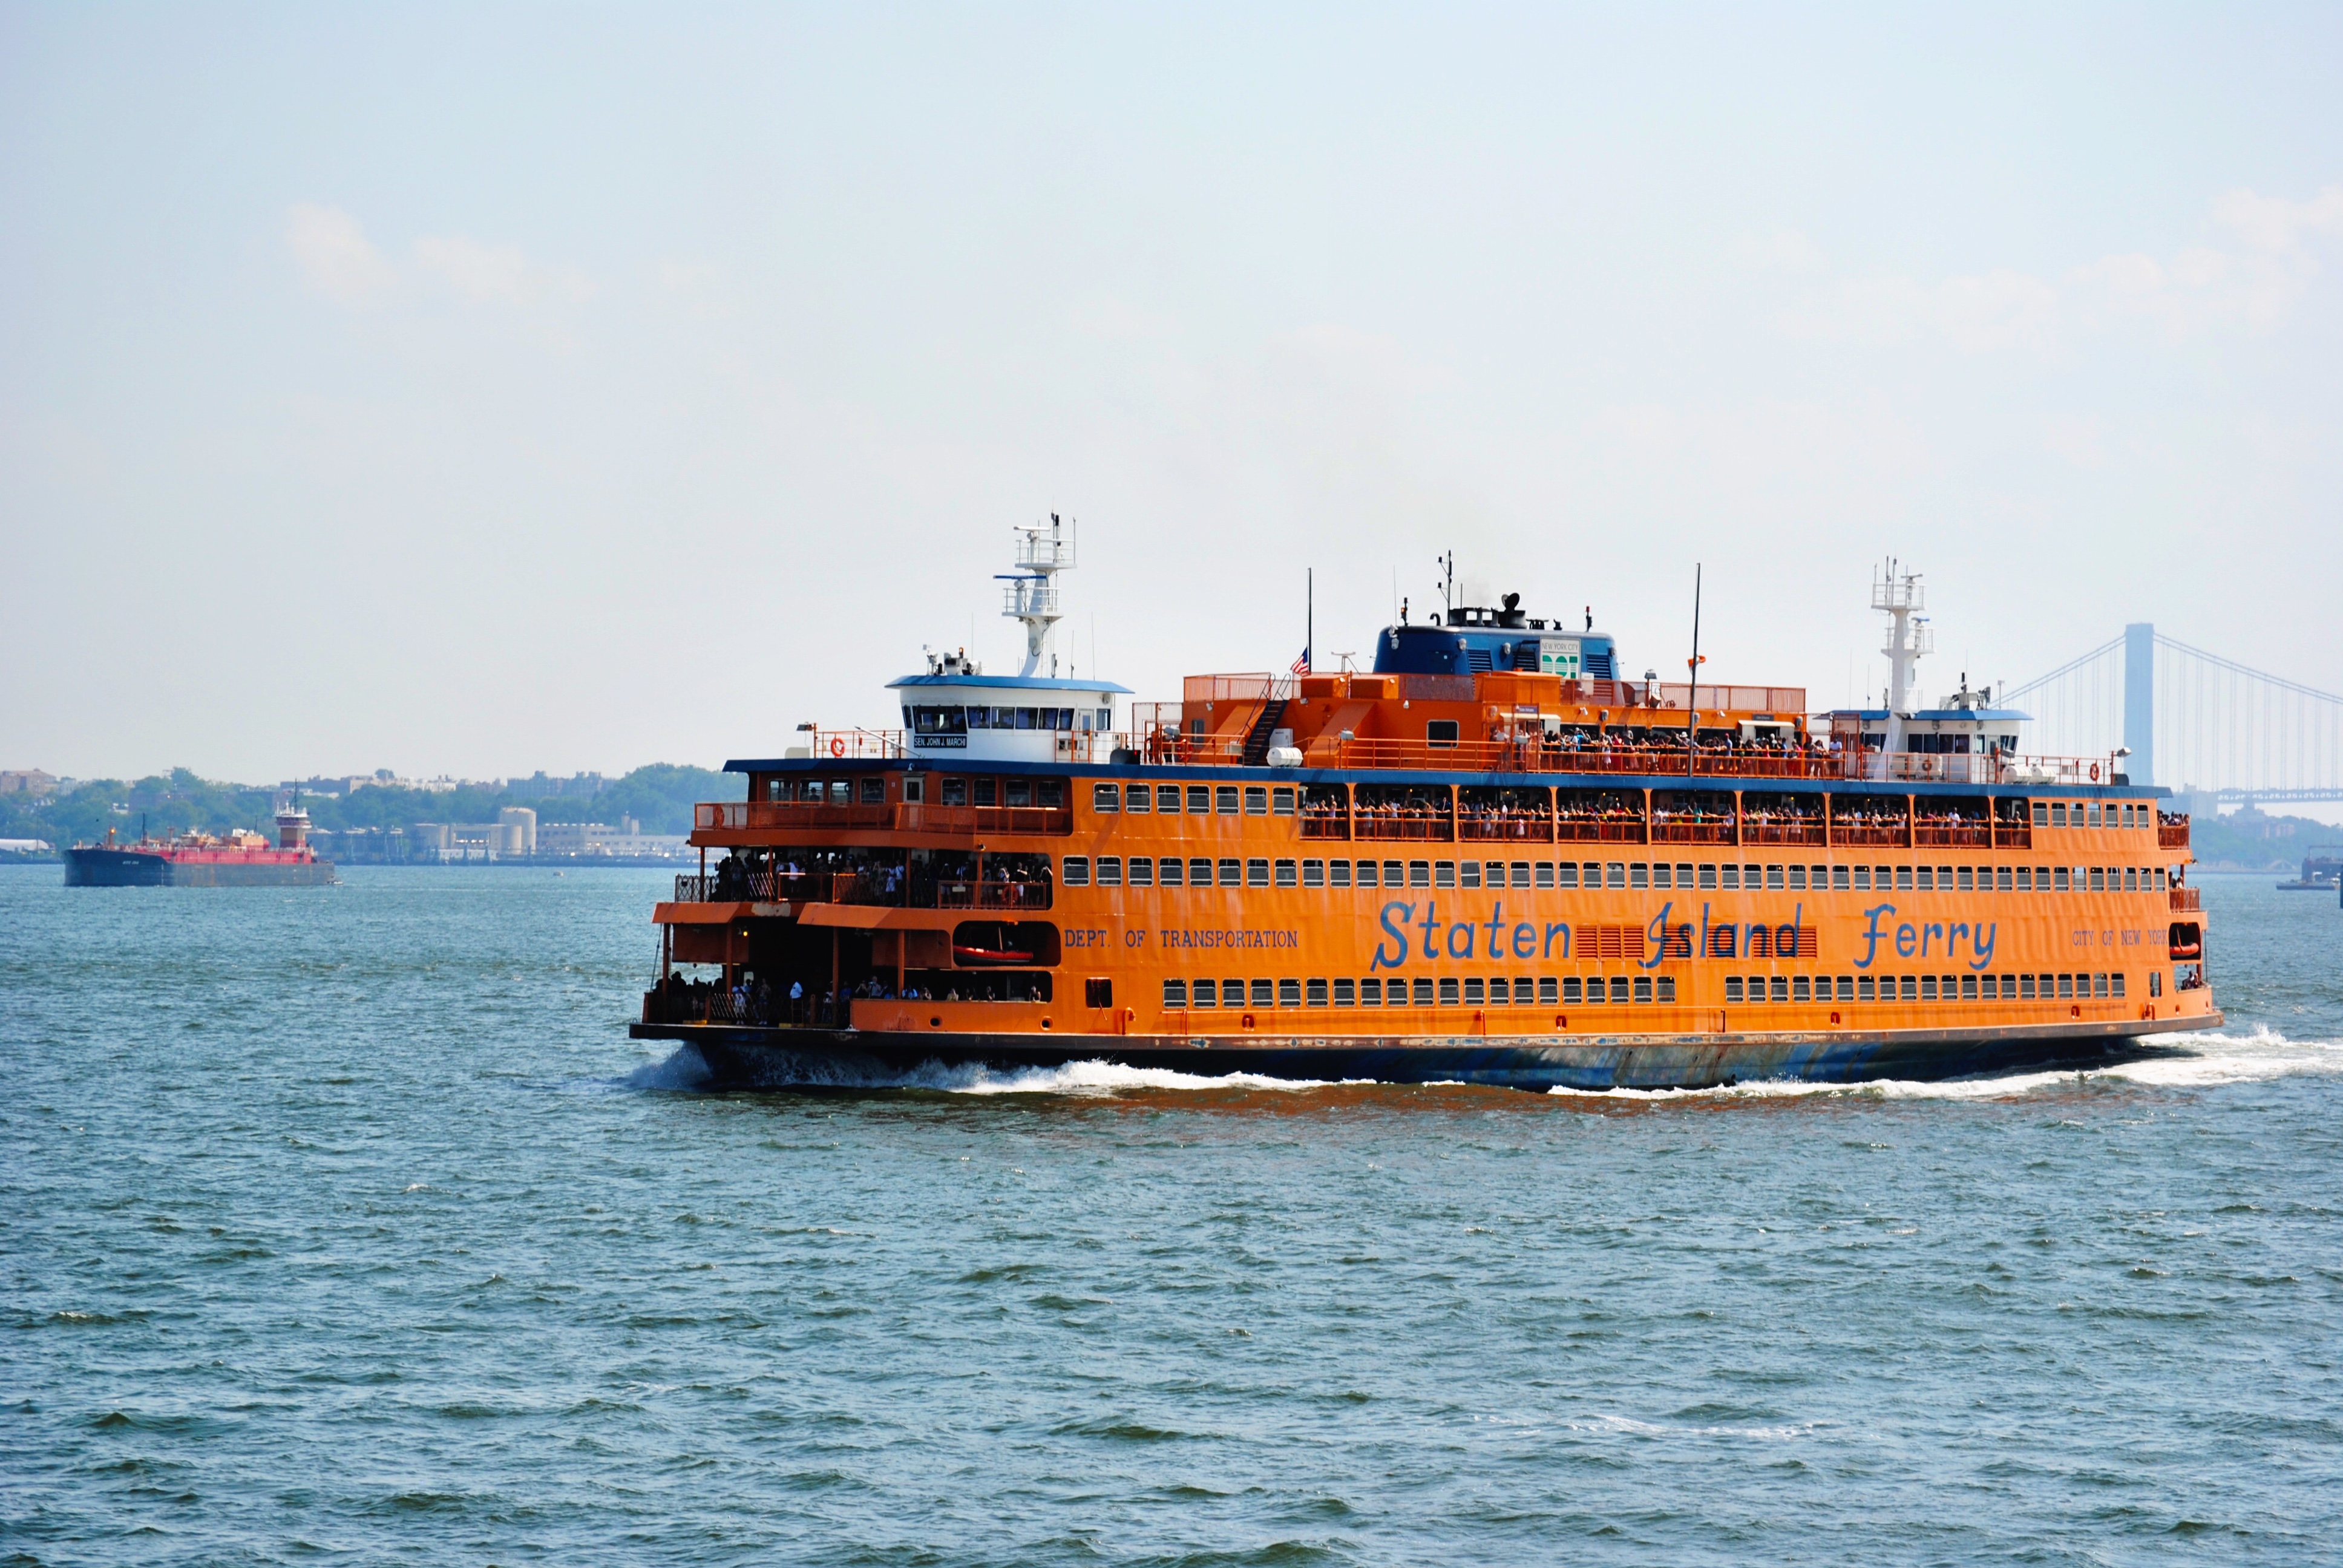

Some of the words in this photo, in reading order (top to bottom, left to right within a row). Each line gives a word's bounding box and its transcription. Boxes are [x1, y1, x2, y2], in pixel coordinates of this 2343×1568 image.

[914, 737, 925, 746] SEN.
[926, 737, 940, 746] JOHN
[940, 737, 945, 746] J.
[946, 737, 966, 746] MARCHI
[1064, 929, 1111, 948] DEPT.
[1125, 930, 1146, 948] OF
[1160, 930, 1298, 948] TRANSPORTATION
[1369, 901, 1571, 973] Staten
[1637, 901, 1802, 969] Island
[1852, 903, 1997, 971] Ferry
[2072, 930, 2094, 946] CITY
[2102, 930, 2114, 946] OF
[2120, 929, 2141, 946] NEW
[2148, 929, 2168, 945] YORK
